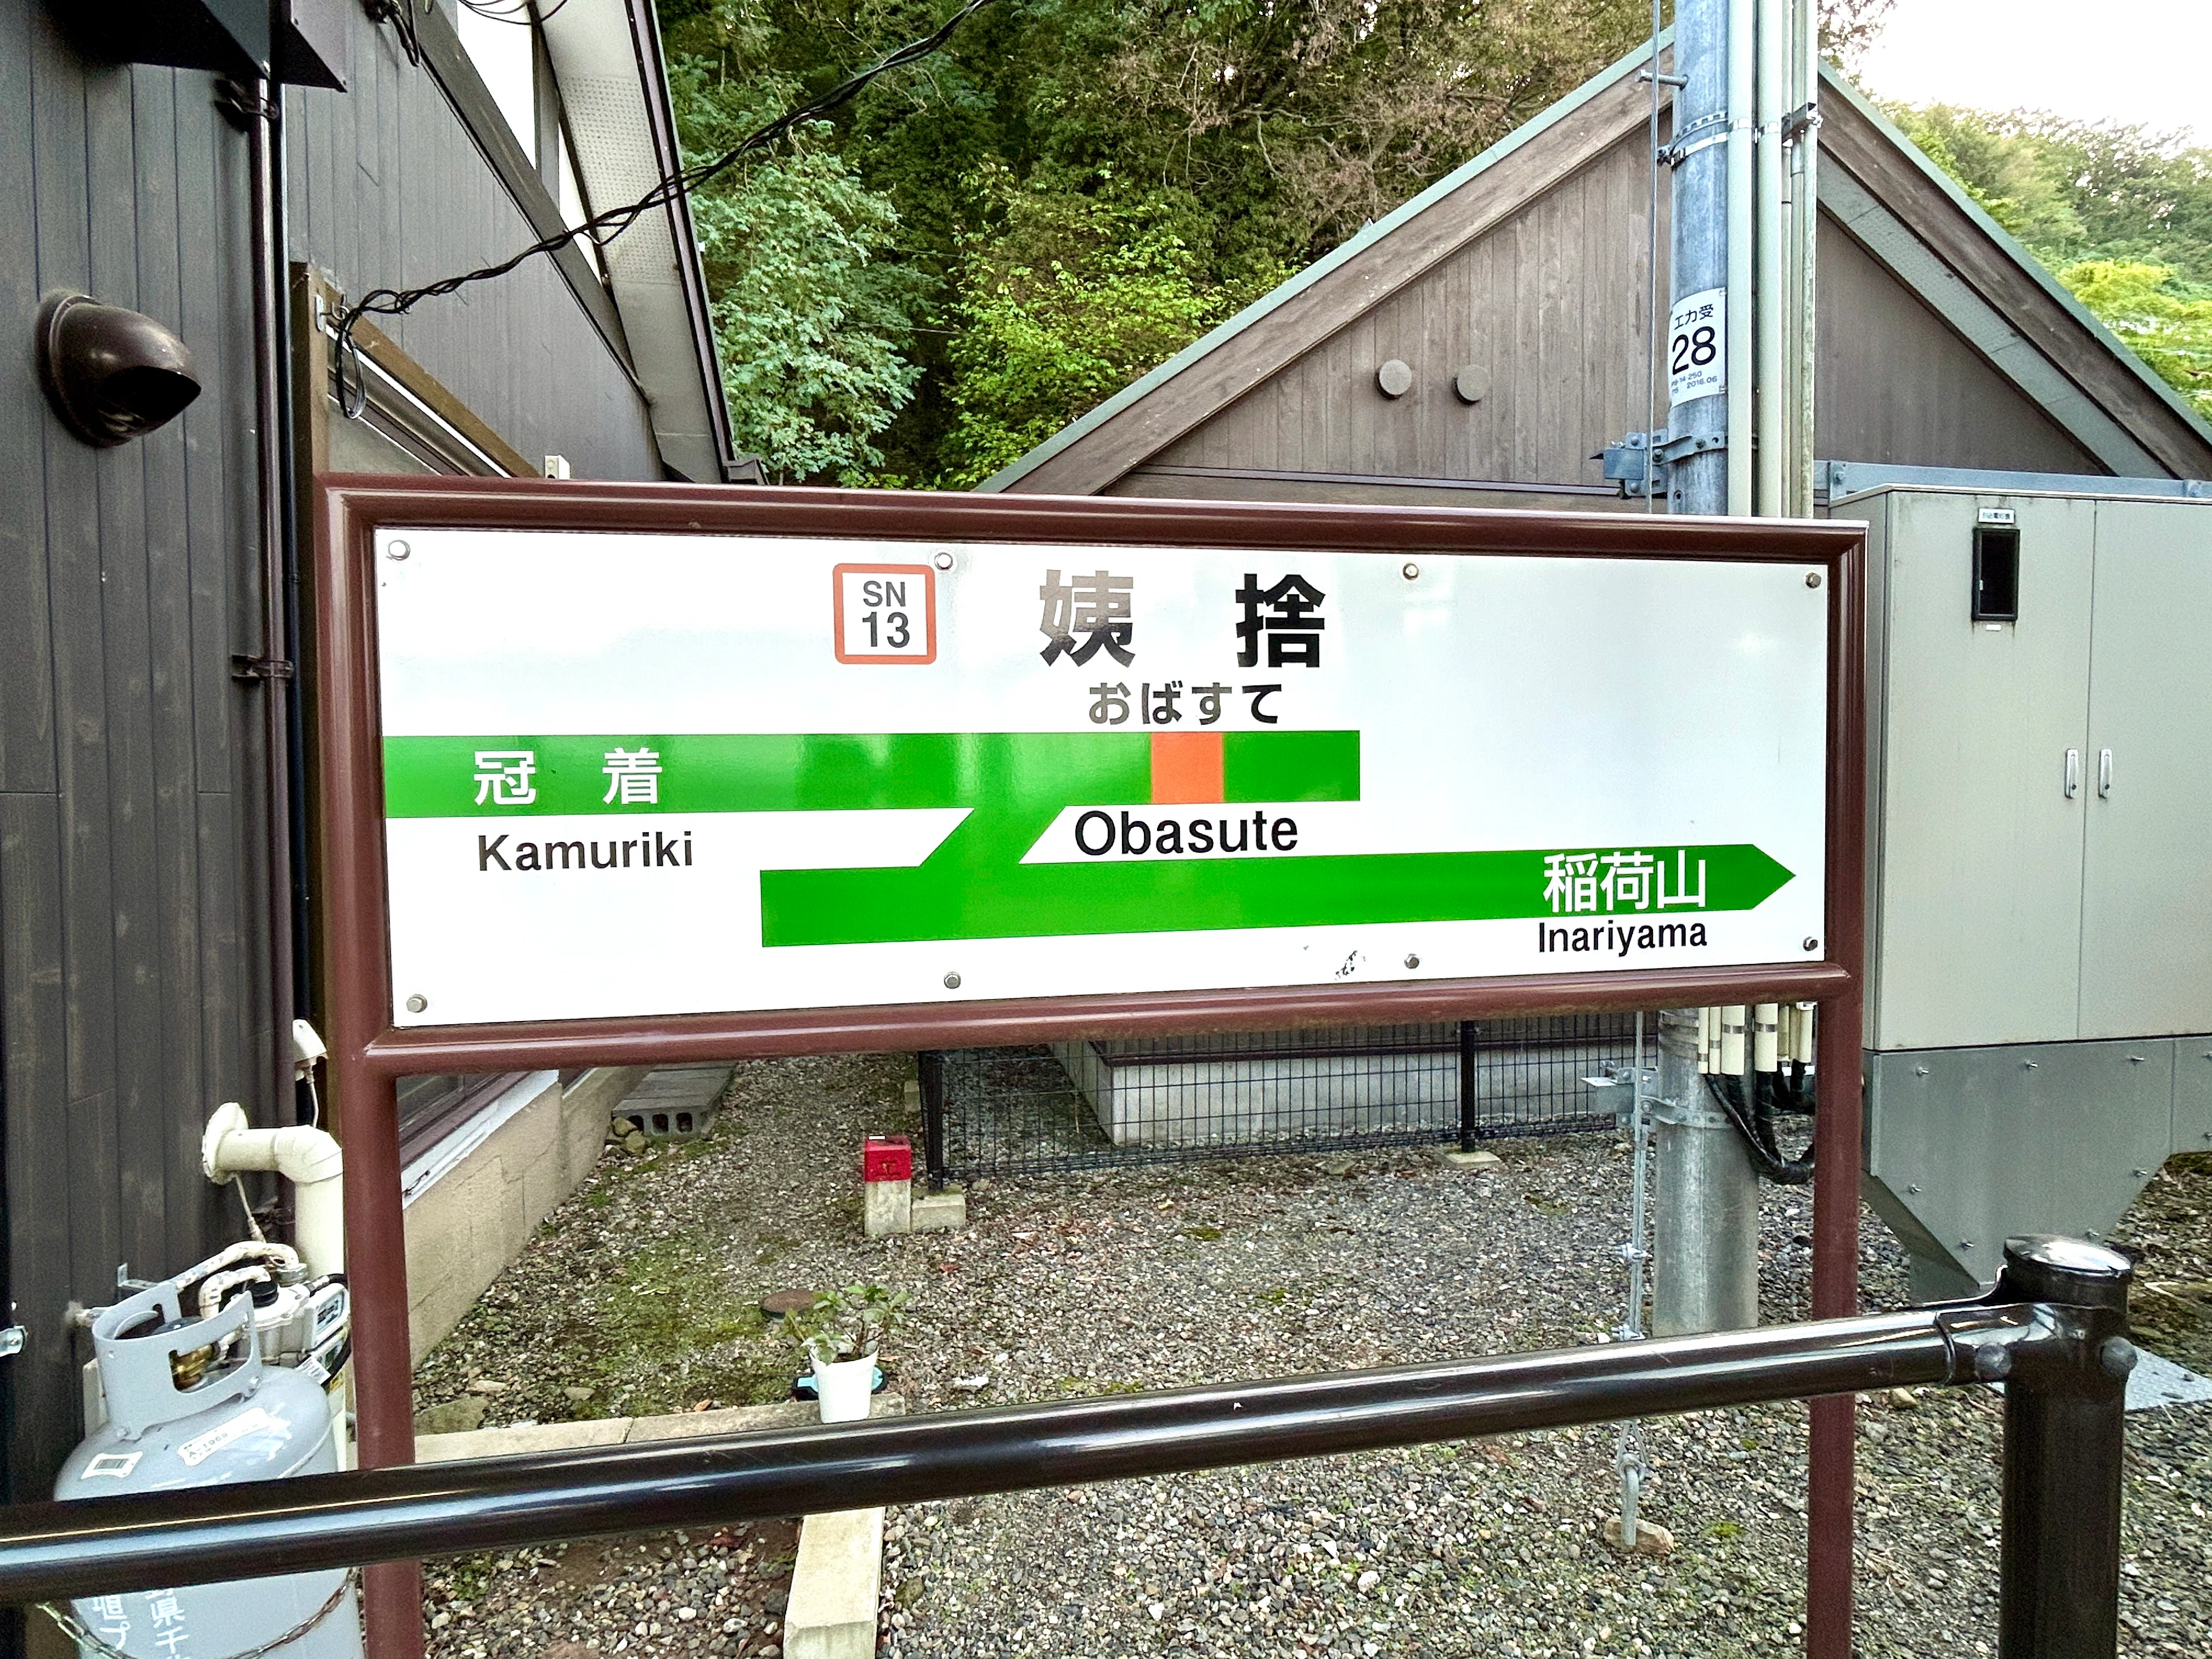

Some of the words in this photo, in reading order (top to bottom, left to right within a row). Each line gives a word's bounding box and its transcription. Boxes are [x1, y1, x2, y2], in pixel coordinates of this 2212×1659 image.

[1672, 326, 1716, 375] 28
[862, 580, 906, 607] SN
[862, 611, 911, 648] 13
[1039, 569, 1327, 668] 姨捨
[1088, 680, 1282, 725] おばすて
[473, 747, 663, 805] 冠着
[478, 831, 692, 871] Kamuriki
[1075, 810, 1298, 855] Obasute
[1543, 849, 1706, 913] 稲荷山
[1539, 919, 1707, 957] Inariyama
